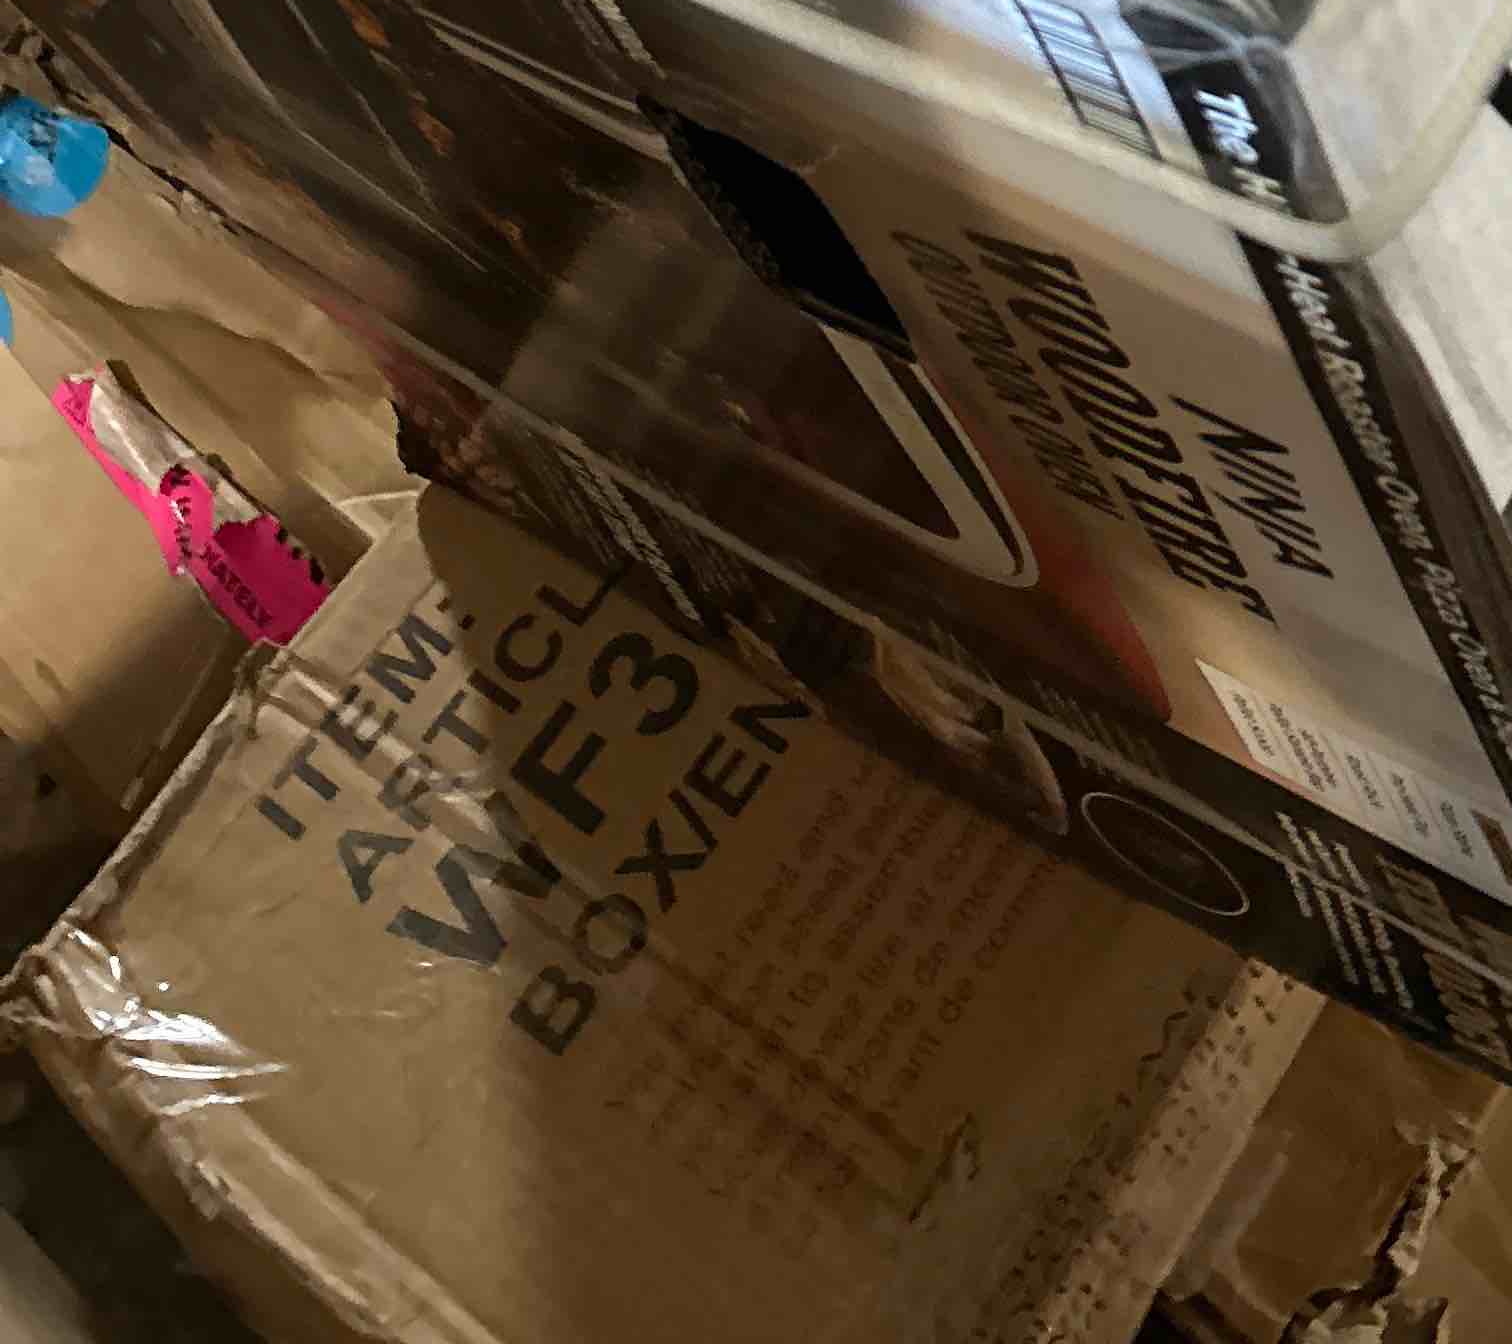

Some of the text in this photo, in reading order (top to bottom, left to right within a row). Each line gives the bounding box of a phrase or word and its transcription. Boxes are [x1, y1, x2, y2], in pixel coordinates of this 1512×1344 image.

[881, 219, 1125, 522] OUTDOOR OVEN
[949, 205, 1276, 626] WOODFIRE
[1168, 392, 1342, 594] NINJA
[1185, 72, 1269, 174] The
[1228, 160, 1358, 359] H-Heat
[1307, 338, 1405, 477] Roaster
[1410, 552, 1478, 637] Pizza
[250, 582, 479, 845] ITEM:
[316, 530, 634, 907] ARTICL
